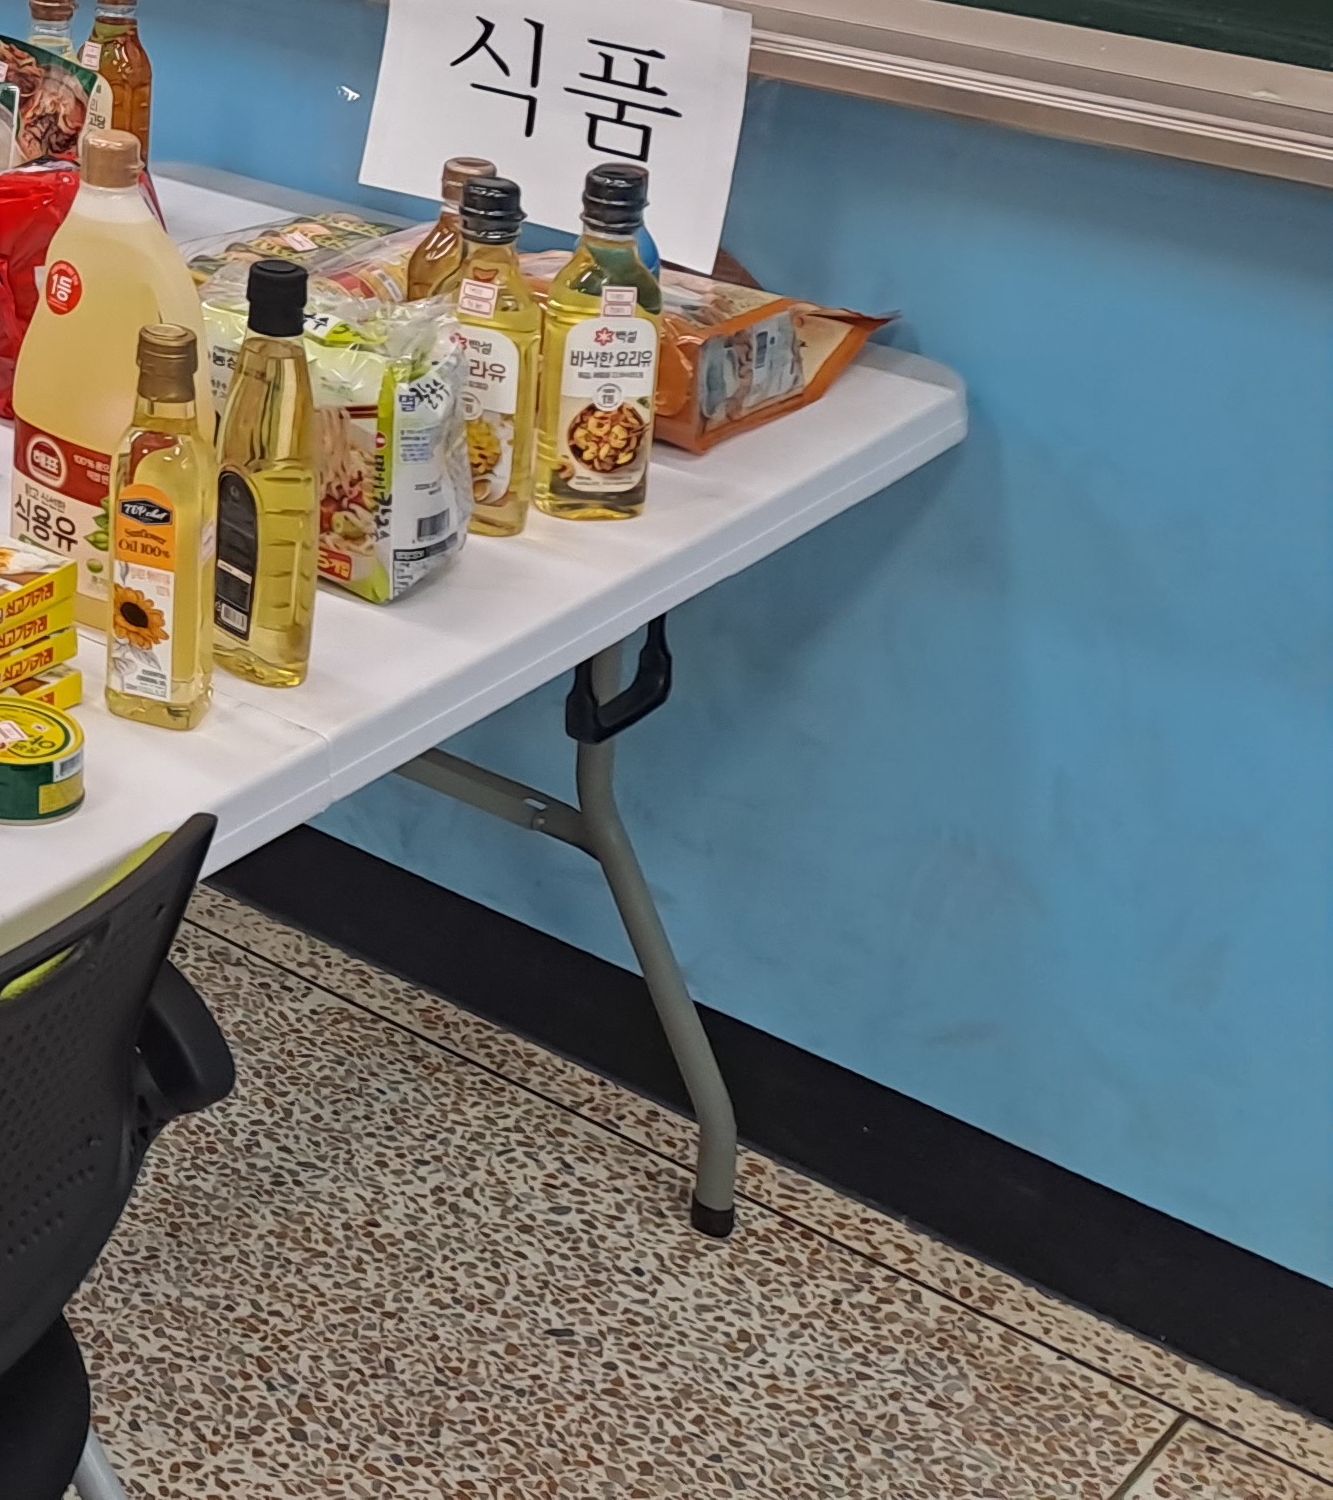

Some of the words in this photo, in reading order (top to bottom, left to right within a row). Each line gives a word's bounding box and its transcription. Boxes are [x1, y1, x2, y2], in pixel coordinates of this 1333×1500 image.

[450, 15, 682, 163] 식품
[616, 329, 637, 345] 백설
[569, 350, 614, 369] 바삭한
[14, 493, 79, 552] 식용유
[118, 537, 138, 554] Oil
